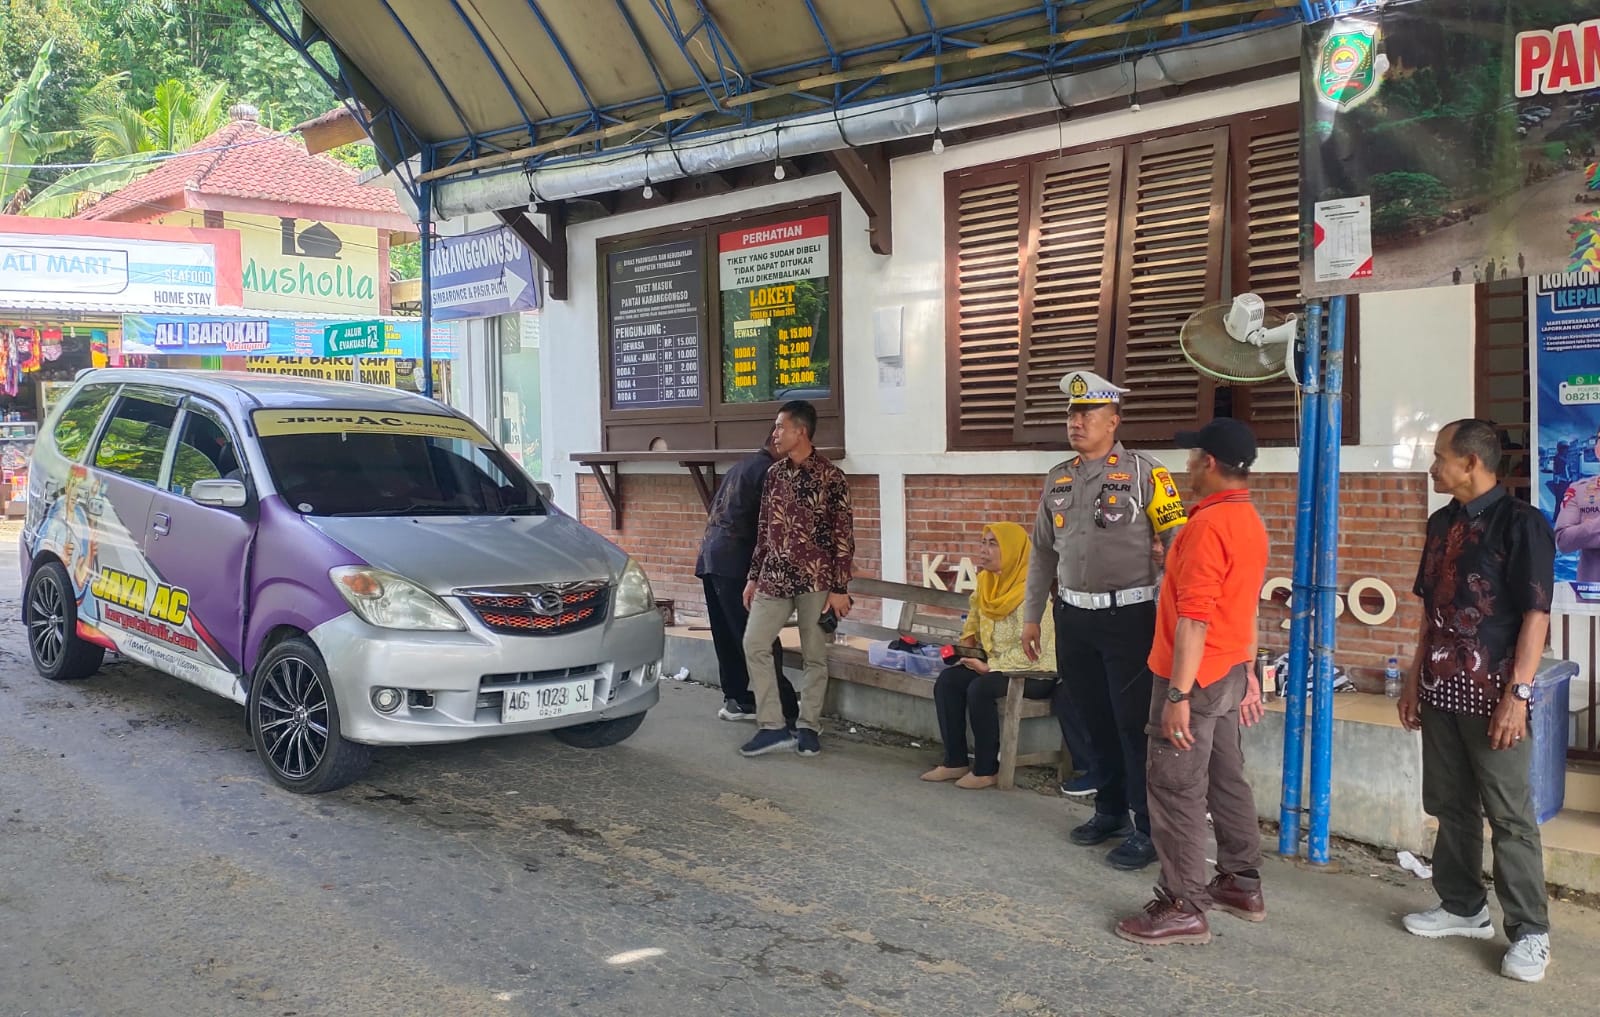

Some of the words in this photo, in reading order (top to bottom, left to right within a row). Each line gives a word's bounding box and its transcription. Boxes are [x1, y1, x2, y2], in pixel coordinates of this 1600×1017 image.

[742, 224, 803, 245] PERHATIAN
[727, 255, 747, 266] TIKET
[749, 252, 768, 263] YANG
[769, 248, 795, 259] SUDAH
[796, 243, 821, 254] DIBELI
[1, 254, 37, 272] ALI
[47, 254, 112, 275] MART
[734, 266, 755, 275] TIDAK
[756, 261, 778, 272] DAPAT
[780, 256, 814, 268] DITUKAR
[164, 268, 212, 284] SEAFOOD
[736, 275, 755, 286] ATAU
[756, 267, 811, 283] DIKEMBALIKAN
[473, 284, 490, 298] PASIR
[635, 283, 651, 295] TIKET
[652, 280, 674, 292] MASUK
[154, 290, 184, 305] HOME
[187, 291, 212, 305] STAY
[621, 296, 641, 308] PANTAI
[749, 284, 796, 308] LOKET
[1557, 287, 1600, 307] KEPA
[155, 322, 183, 346] ALI
[188, 321, 268, 345] BAROKAH
[344, 327, 362, 338] JALUR
[615, 324, 662, 339] PENGUNJUNG
[339, 338, 367, 350] EVAKUASI
[622, 341, 645, 351] DEWASA
[677, 349, 697, 359] 10.000
[680, 362, 697, 372] 2.000
[335, 369, 354, 382] IKA
[360, 370, 391, 385] BAKAR
[1565, 392, 1590, 401] 0821
[1049, 485, 1073, 495] AGUS
[1101, 483, 1132, 492] POLRI
[91, 567, 148, 614] JAYA
[149, 582, 189, 627] AC
[536, 687, 568, 708] 1023
[575, 684, 589, 702] SL
